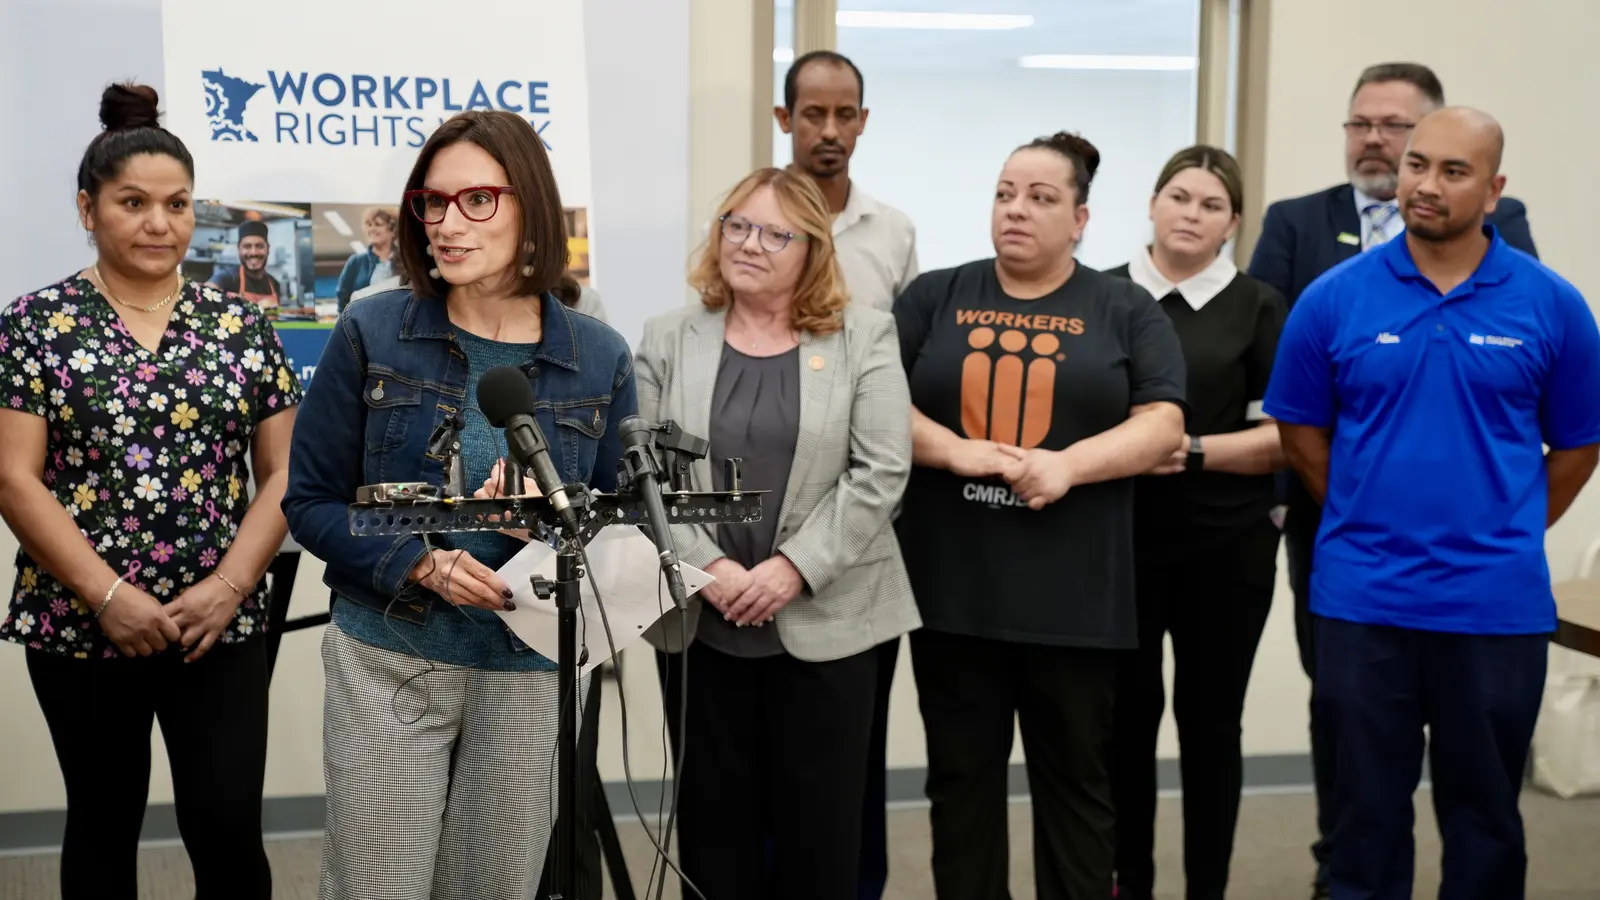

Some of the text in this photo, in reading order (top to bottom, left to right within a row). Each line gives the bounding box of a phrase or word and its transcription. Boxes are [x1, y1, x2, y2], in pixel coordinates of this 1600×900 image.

[267, 70, 550, 114] WORKPLACE
[275, 112, 426, 148] RIGHTS
[956, 309, 1085, 335] WORKERS
